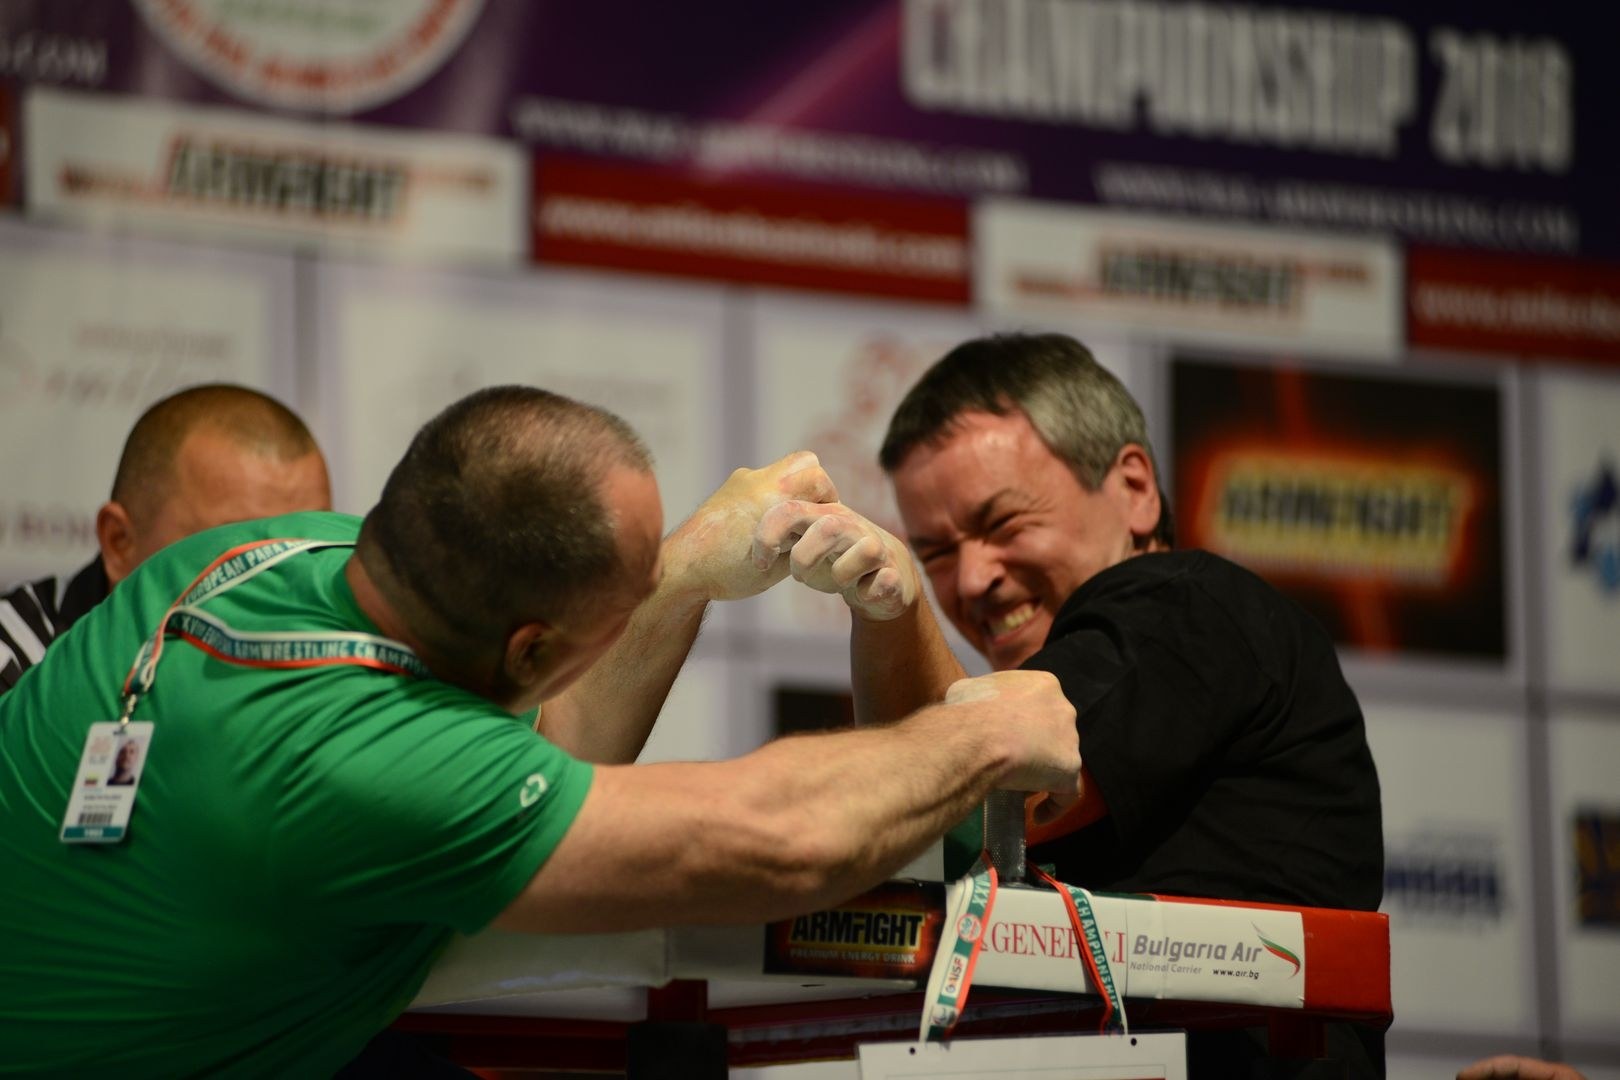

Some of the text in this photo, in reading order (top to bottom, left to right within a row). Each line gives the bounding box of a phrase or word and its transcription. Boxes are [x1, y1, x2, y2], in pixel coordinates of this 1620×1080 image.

[234, 641, 349, 661] ARMWRESTLING
[354, 641, 429, 676] CHAMPIO
[790, 910, 923, 948] ARMFIGHT
[991, 921, 1126, 964] GENERI
[841, 950, 881, 963] ENERGY
[882, 952, 916, 965] DRINK
[1073, 897, 1119, 1010] CHAMPIONSHIP
[1132, 934, 1263, 963] Bulgaria Air
[1129, 961, 1260, 980] National Carrier www.air.bg
